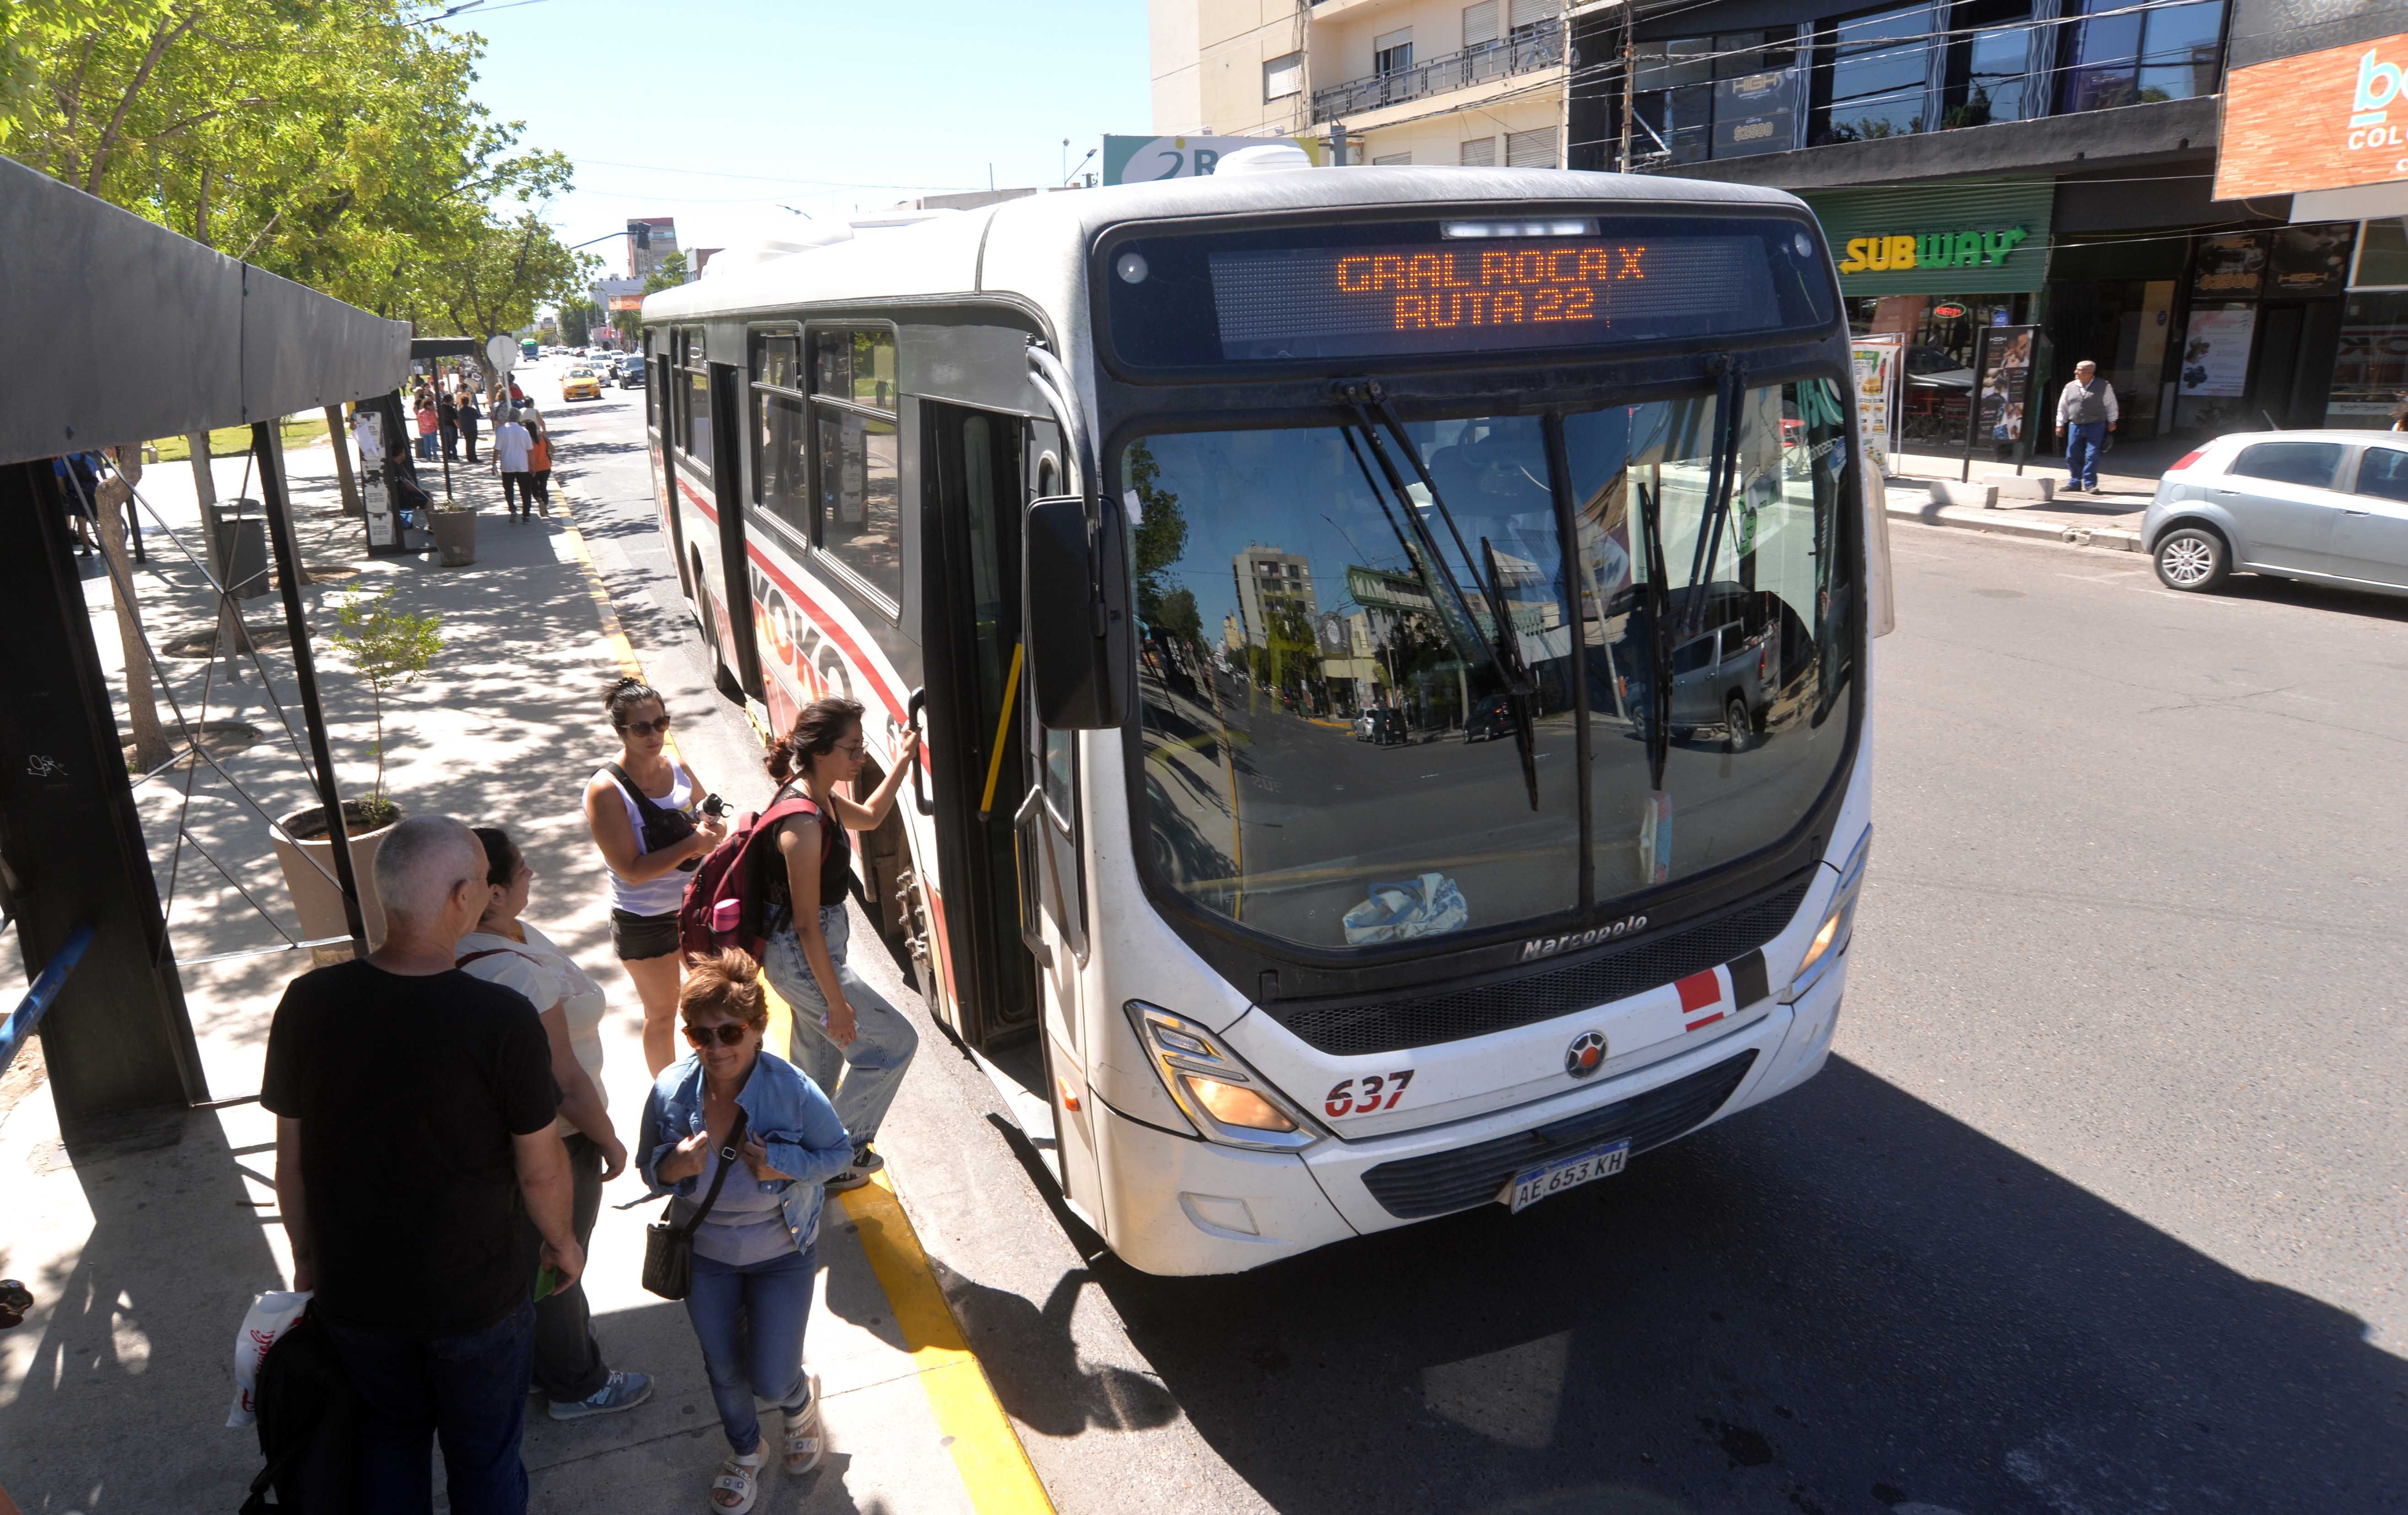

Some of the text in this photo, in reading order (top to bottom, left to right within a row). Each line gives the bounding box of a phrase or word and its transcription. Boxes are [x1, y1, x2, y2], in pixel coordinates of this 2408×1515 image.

[2353, 48, 2408, 113] b
[2348, 125, 2408, 150] COL
[1337, 247, 1645, 291] GRAL ROCA X
[1838, 226, 2028, 275] SUBWAY
[1396, 287, 1594, 329] RUTA 22
[1521, 914, 1648, 962] Marcopolo
[1325, 1069, 1414, 1117] 637
[1518, 1178, 1543, 1206] AE
[1549, 1162, 1590, 1191] 653
[1595, 1151, 1623, 1176] KH
